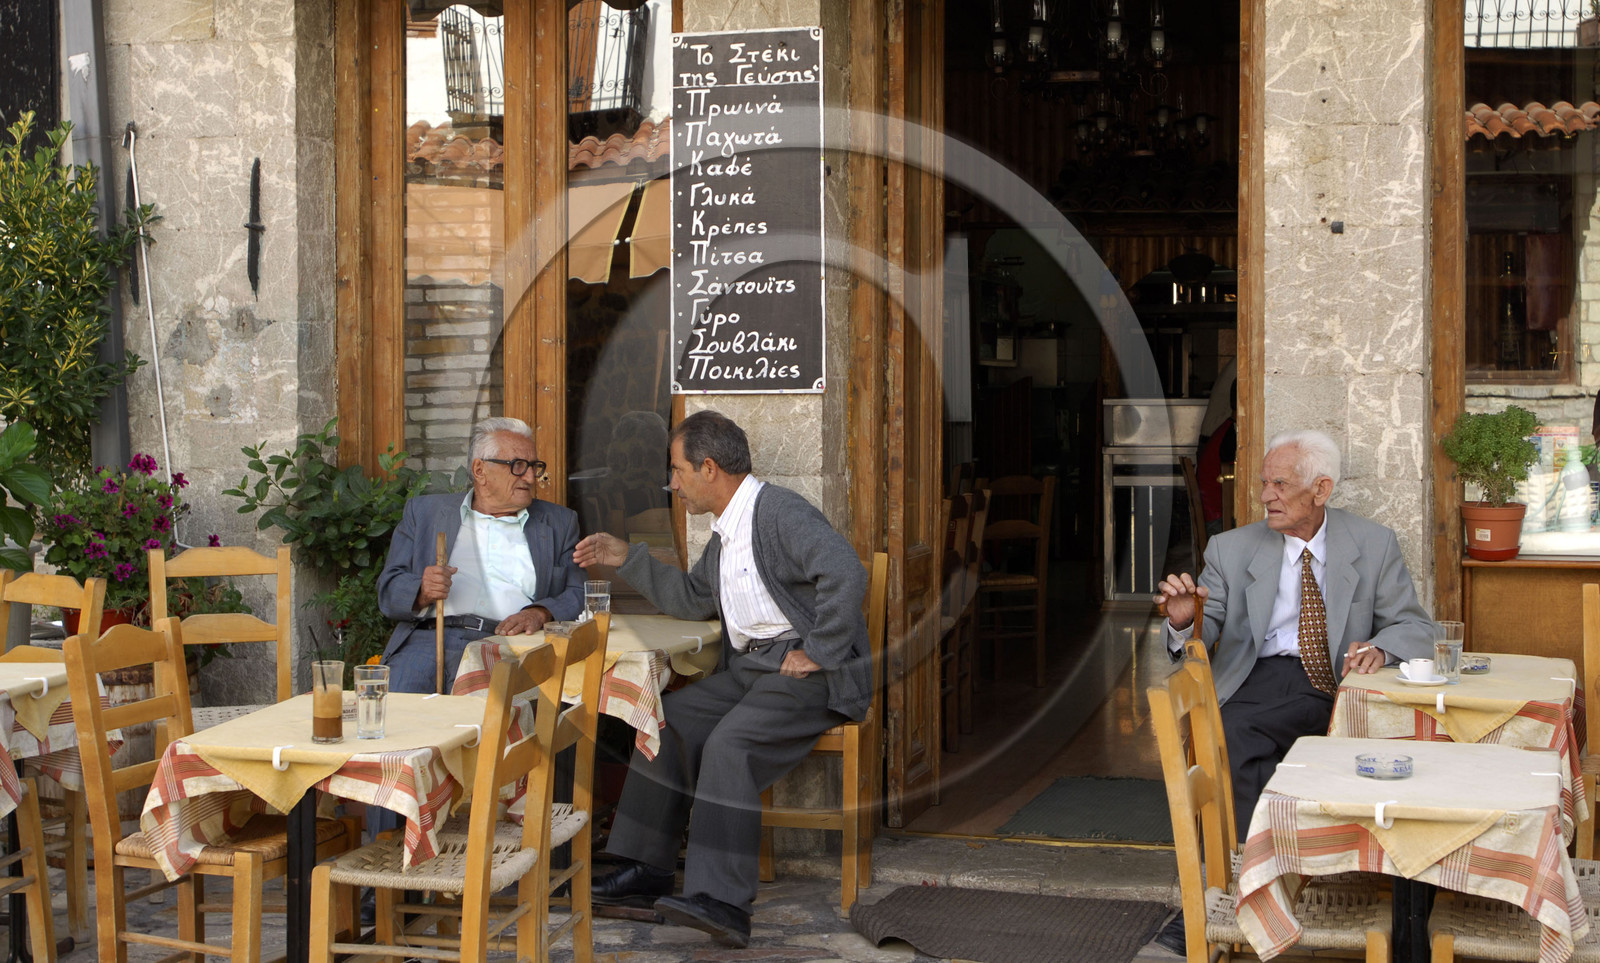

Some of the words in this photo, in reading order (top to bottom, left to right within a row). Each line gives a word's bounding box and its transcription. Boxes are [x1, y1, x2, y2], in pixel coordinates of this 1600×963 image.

[729, 43, 800, 63] Στέκι
[680, 72, 717, 86] της
[686, 89, 784, 126] Πρωινά
[685, 121, 783, 157] Παγωτά
[690, 150, 752, 176] Καφέ
[690, 183, 756, 206] Γλυκά
[691, 210, 768, 247] Κρέπες
[689, 240, 764, 266] Πίτσα
[690, 298, 740, 336] Γύρο
[688, 328, 798, 354] Σουβλάκι
[688, 355, 800, 380] Ποικιλίες
